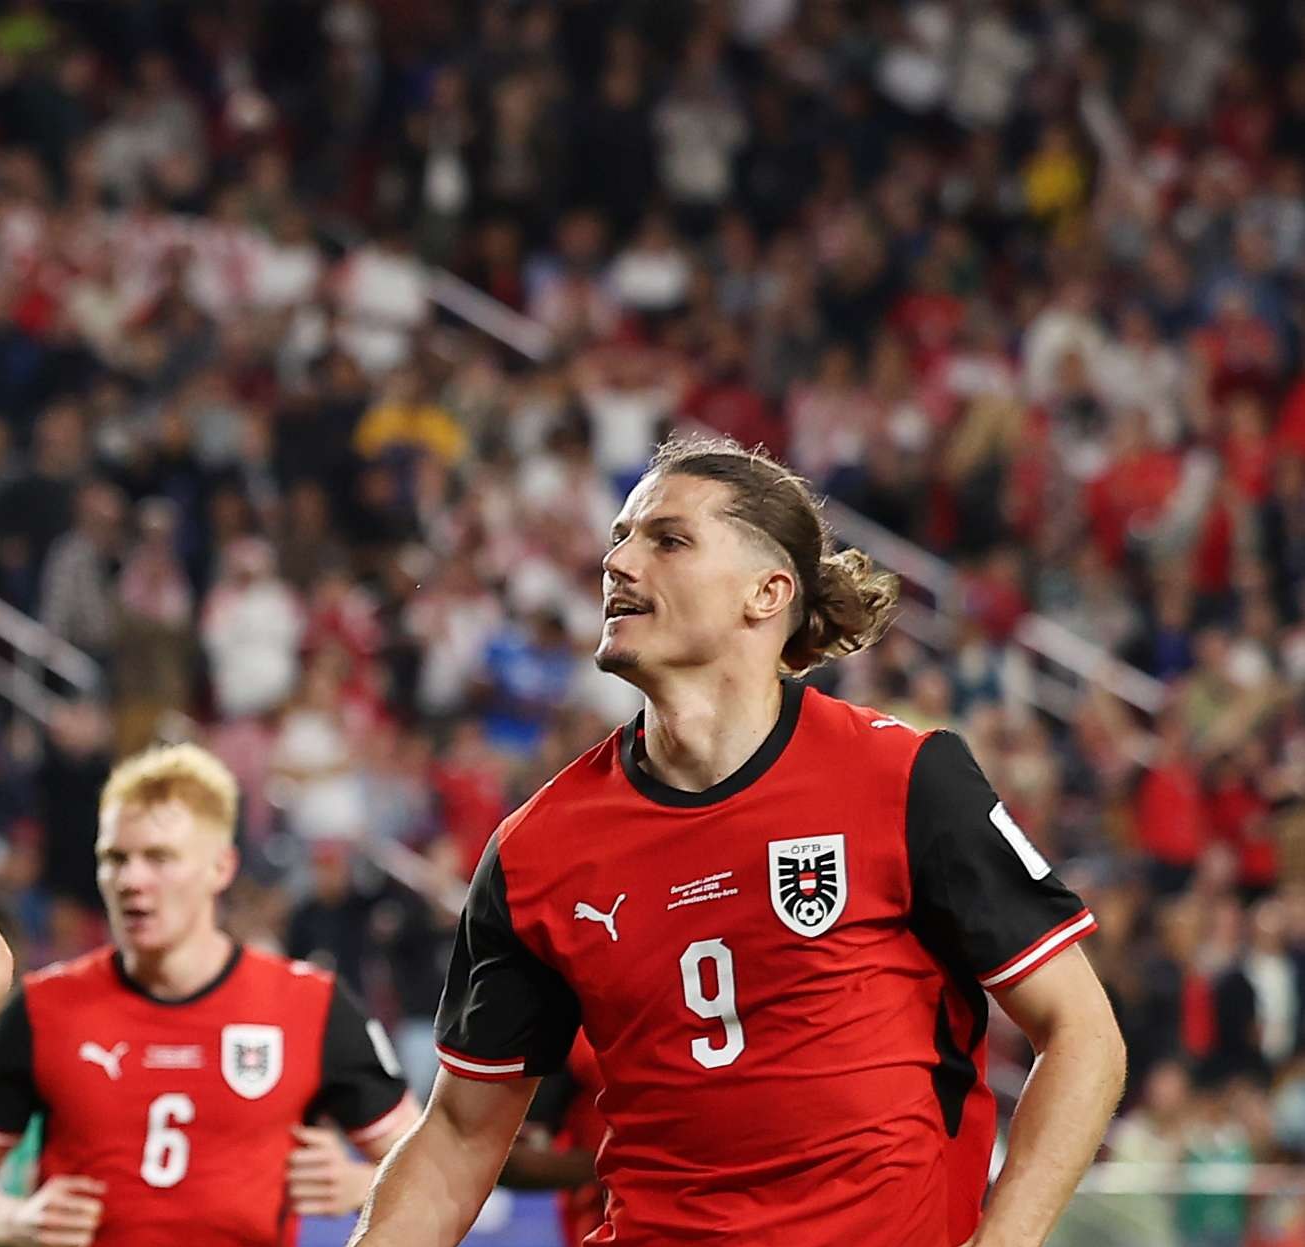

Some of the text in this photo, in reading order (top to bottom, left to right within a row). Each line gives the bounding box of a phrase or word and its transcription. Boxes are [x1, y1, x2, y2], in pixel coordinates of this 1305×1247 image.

[791, 844, 821, 855] ÖFB
[679, 937, 746, 1068] 9
[140, 1092, 195, 1188] 6
